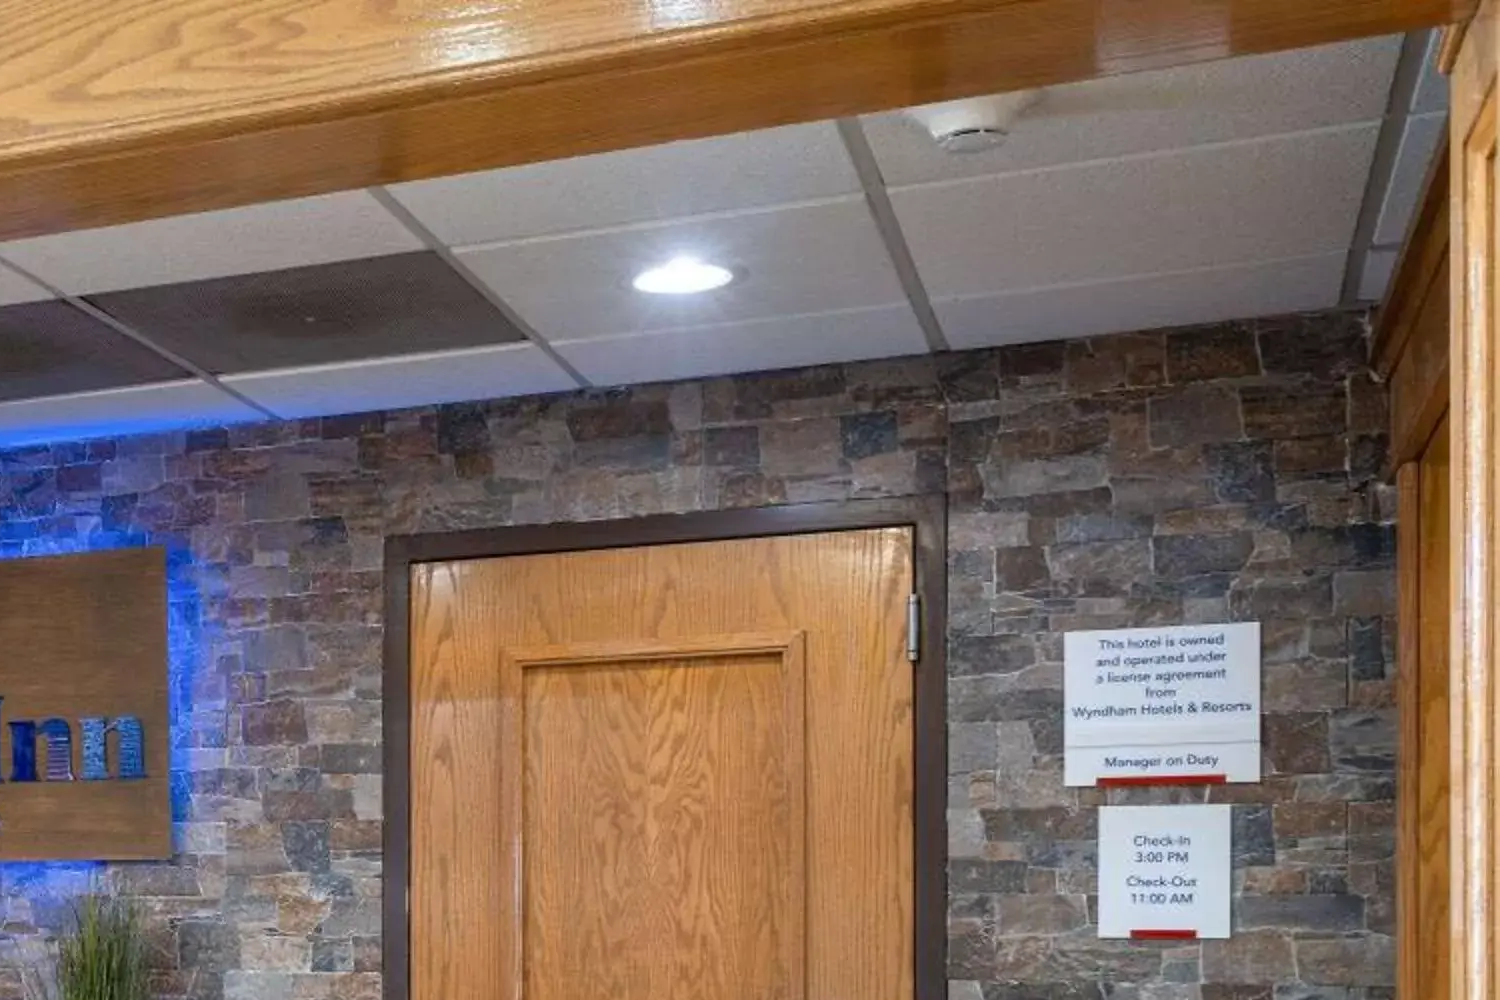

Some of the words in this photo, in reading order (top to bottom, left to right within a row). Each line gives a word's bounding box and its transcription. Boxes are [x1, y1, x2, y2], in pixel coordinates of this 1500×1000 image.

[1099, 639, 1125, 650] This
[1127, 636, 1161, 649] hotel
[1165, 634, 1176, 648] is
[1179, 633, 1225, 647] owned
[1096, 655, 1120, 667] and
[1123, 653, 1185, 668] operated
[1187, 650, 1227, 663] under
[1096, 675, 1104, 684] a
[1107, 671, 1151, 684] license
[1155, 668, 1227, 684] agreement
[1145, 687, 1177, 698] from
[1072, 705, 1137, 720] Wyndham
[1141, 701, 1183, 716] Hotels
[1187, 700, 1198, 713] &
[1201, 700, 1253, 713] Resorts
[1104, 755, 1161, 771] Manager
[1165, 756, 1183, 767] on
[1186, 753, 1219, 768] Duty
[1133, 835, 1191, 847] Check-In
[1134, 851, 1163, 863] 3:00
[1167, 851, 1189, 863] PM
[1125, 875, 1198, 887] Check-Out
[1131, 893, 1167, 904] 11:00
[1169, 893, 1194, 904] AM
